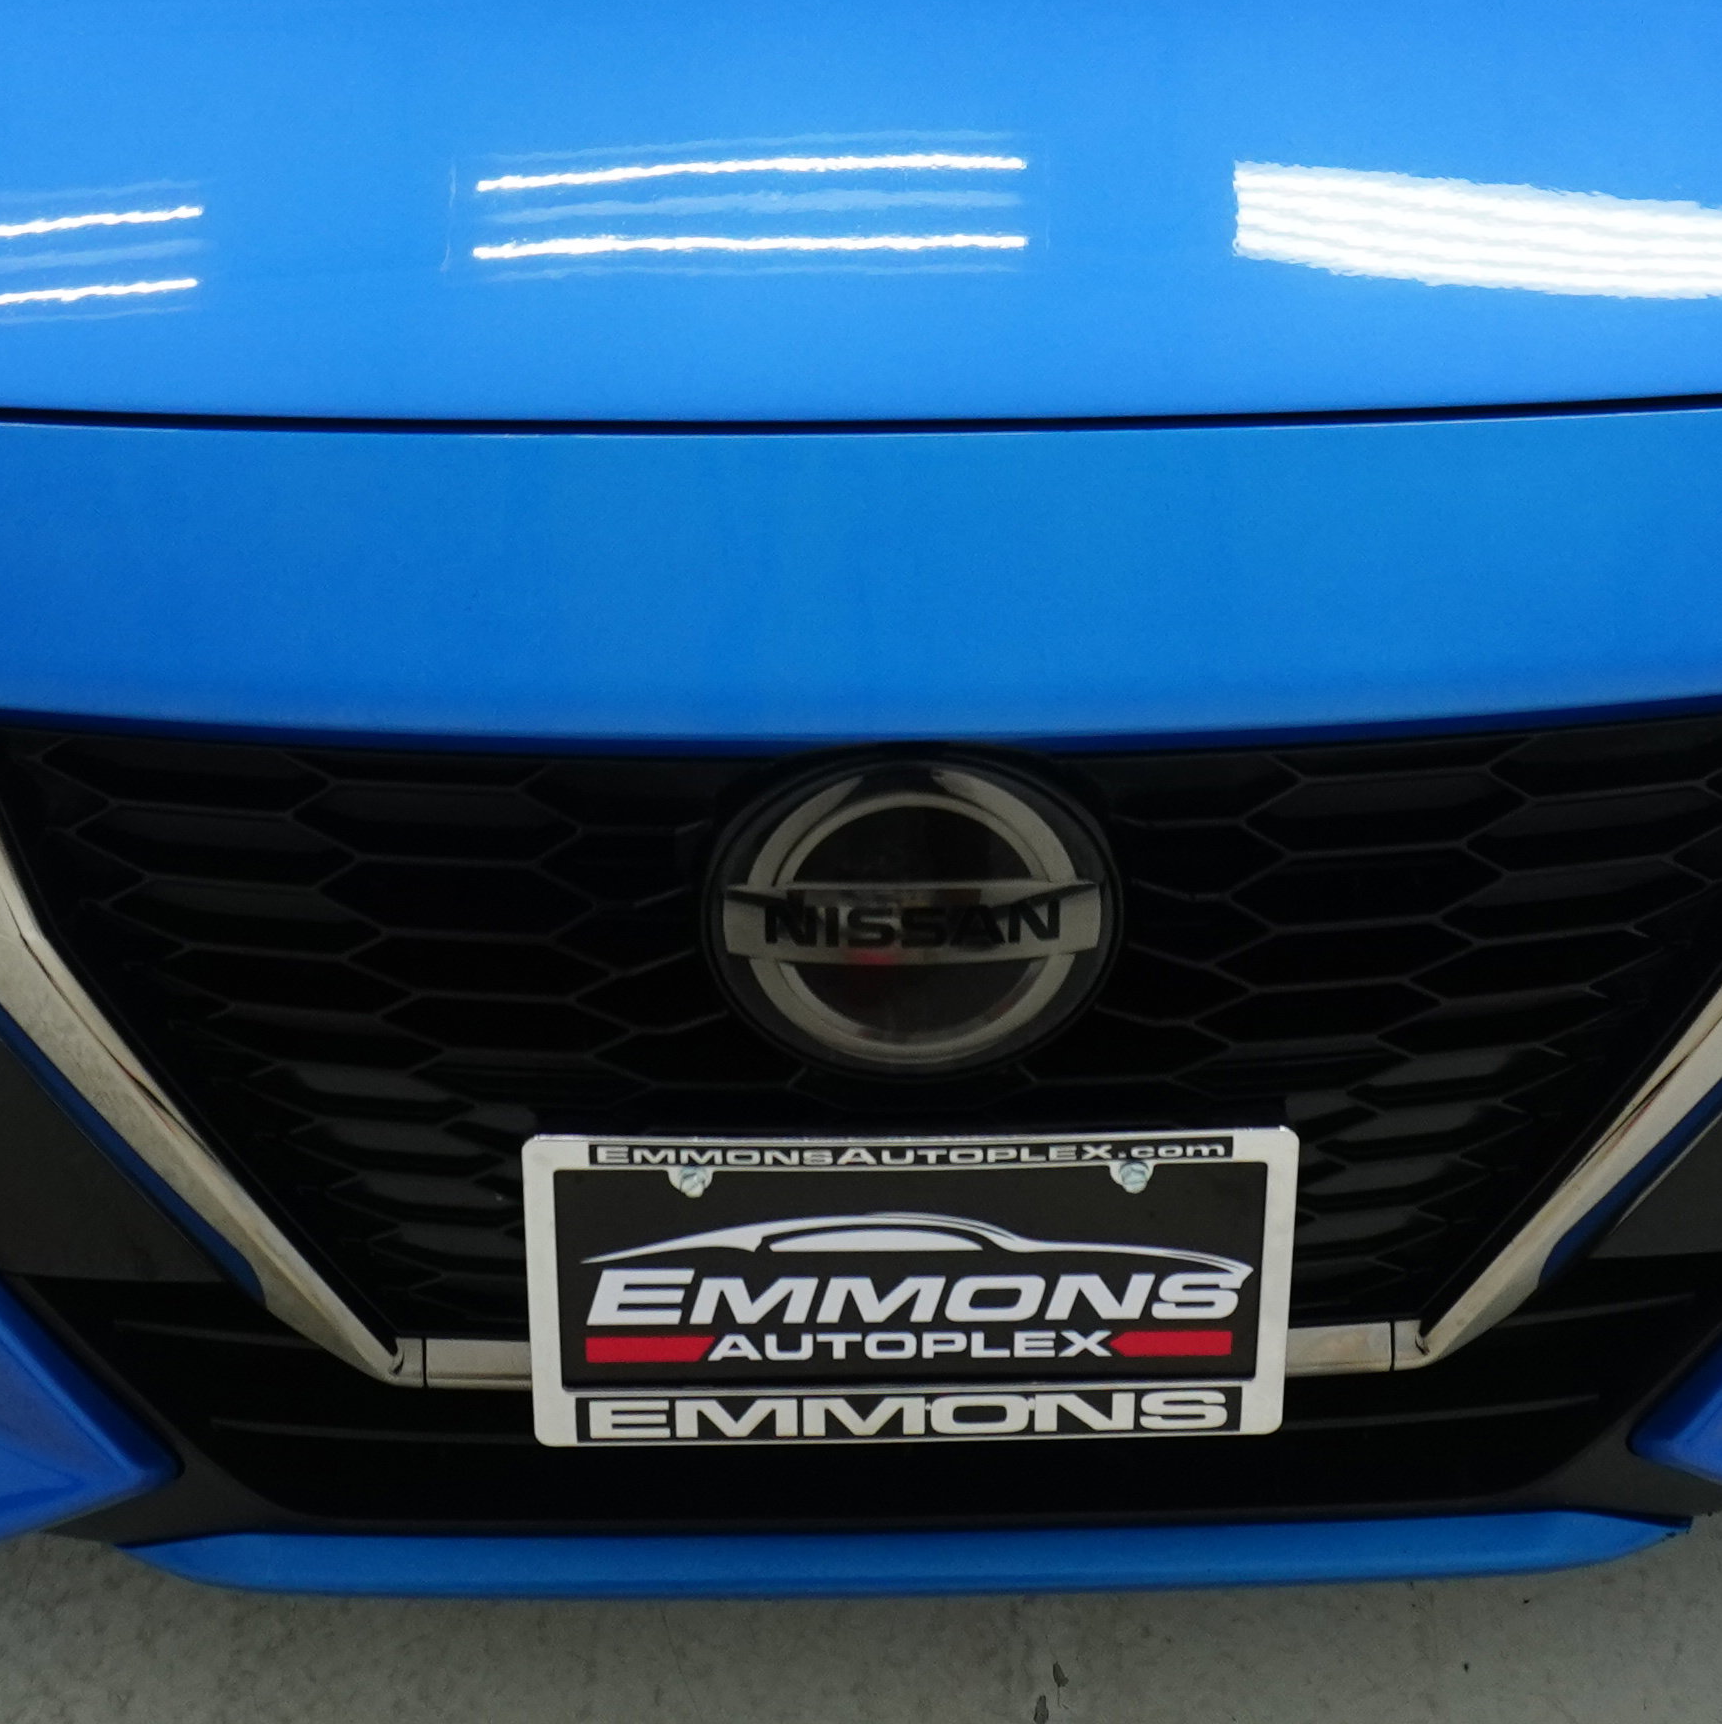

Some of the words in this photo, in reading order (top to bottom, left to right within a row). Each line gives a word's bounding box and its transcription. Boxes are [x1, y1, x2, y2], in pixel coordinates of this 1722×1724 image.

[764, 898, 1061, 948] NISSAN
[585, 1268, 1239, 1326] EMMONS
[707, 1330, 1113, 1362] AUTOPLEX
[588, 1390, 1229, 1440] EMMONS
